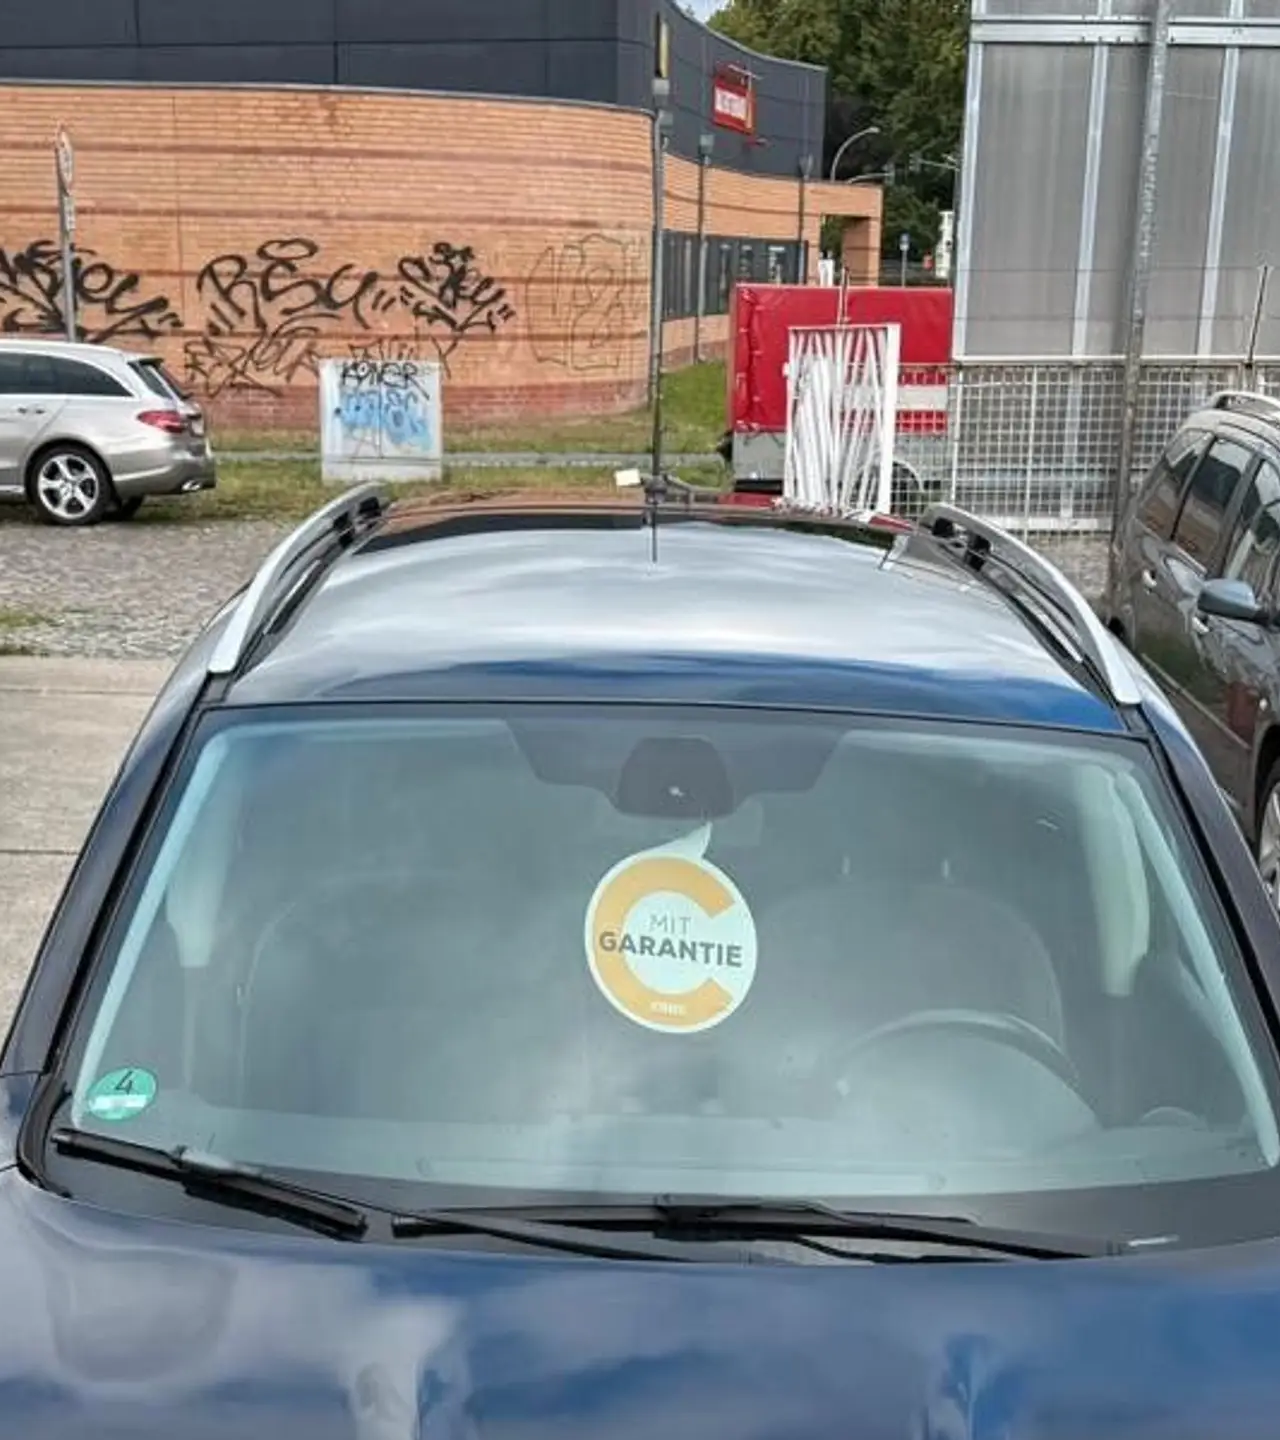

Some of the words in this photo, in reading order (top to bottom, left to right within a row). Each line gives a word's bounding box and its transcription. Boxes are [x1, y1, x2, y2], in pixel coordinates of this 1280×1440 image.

[650, 914, 691, 934] MIT
[599, 931, 743, 968] GARANTIE
[114, 1070, 133, 1096] 4
